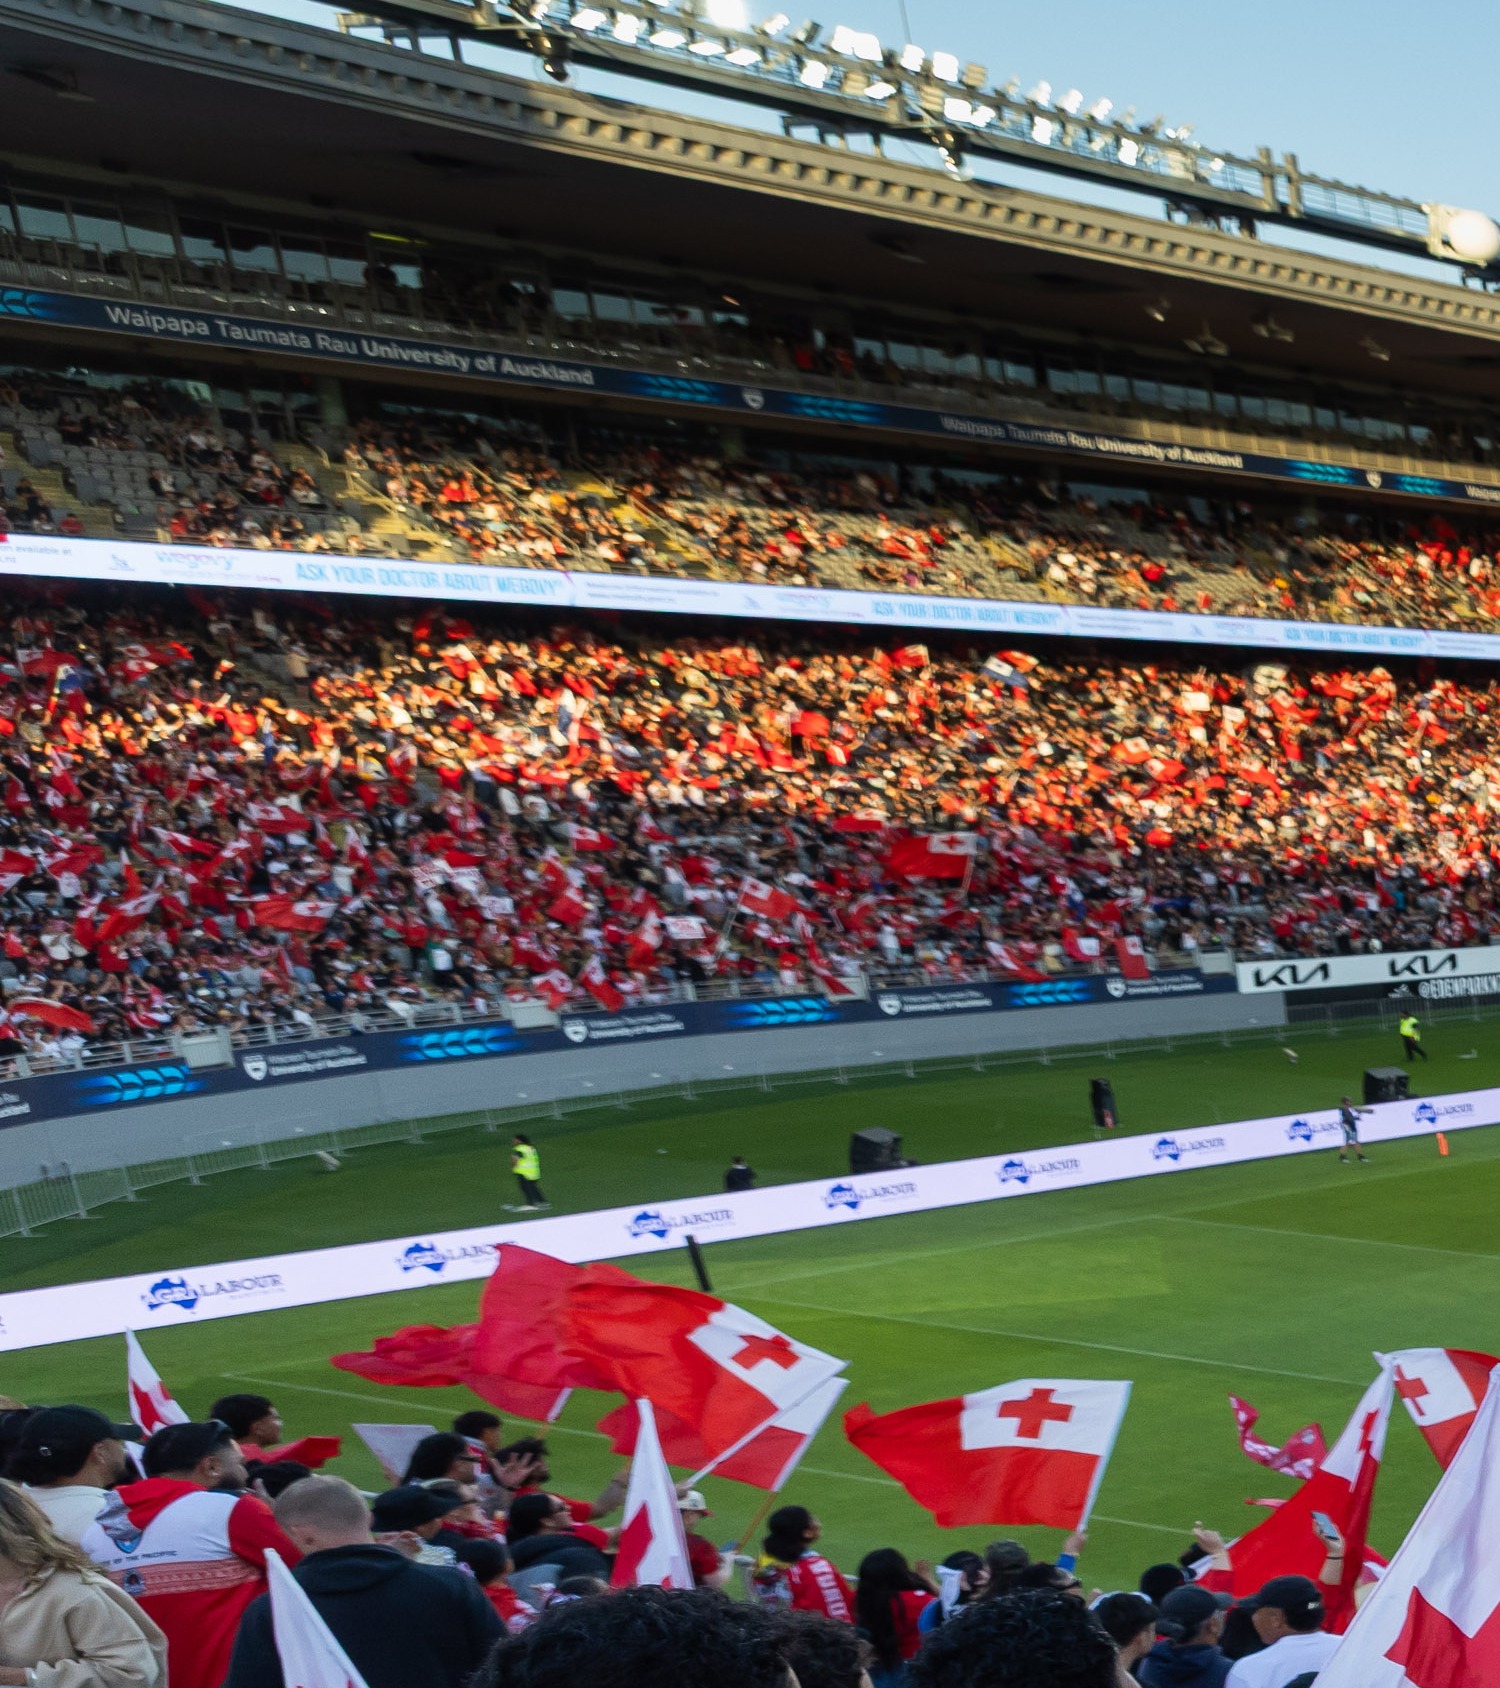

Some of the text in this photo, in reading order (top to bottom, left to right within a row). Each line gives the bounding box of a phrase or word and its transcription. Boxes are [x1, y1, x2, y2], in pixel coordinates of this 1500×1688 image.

[106, 304, 595, 386] Waipapa Taumata Rau University of Auckland
[940, 416, 1243, 468] Waipapa Taumata Rau University of Auckland
[296, 562, 327, 583] ASK
[332, 565, 373, 586] YOUR
[378, 568, 439, 590] DOCTOR
[444, 573, 491, 592] ABOUT
[668, 1208, 734, 1229] LABOUR
[198, 1274, 283, 1297] LABOUR
